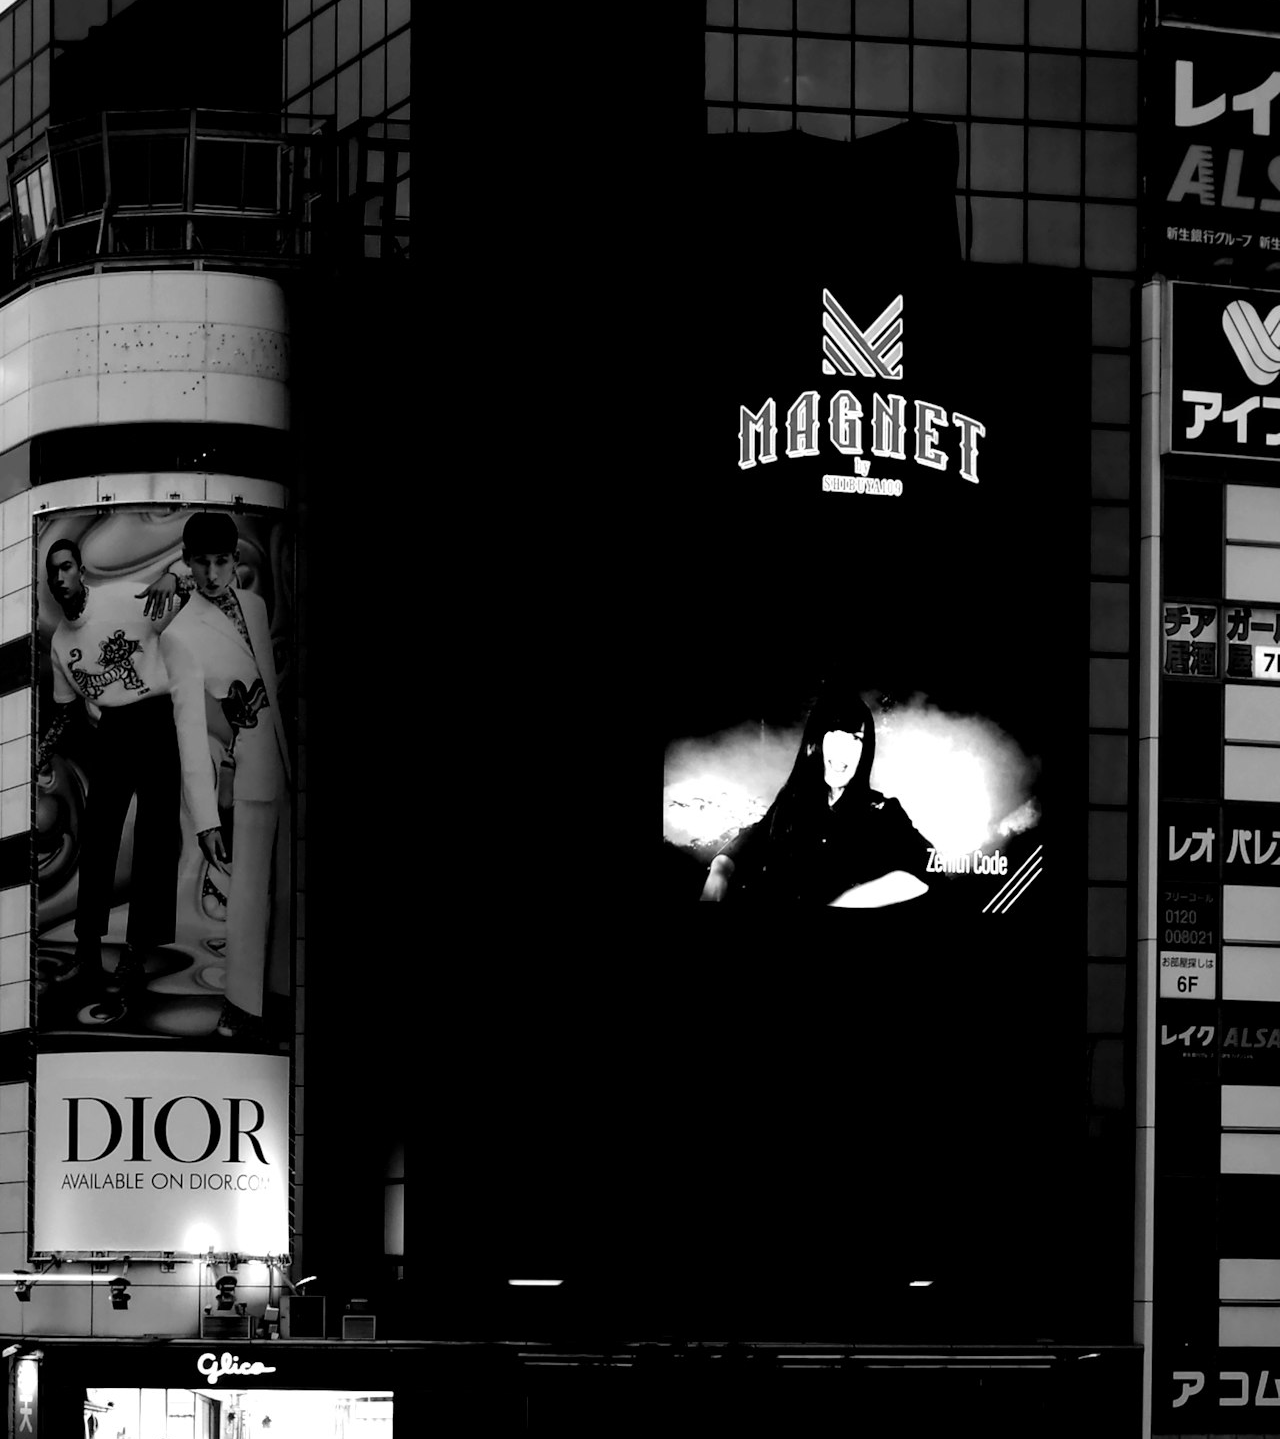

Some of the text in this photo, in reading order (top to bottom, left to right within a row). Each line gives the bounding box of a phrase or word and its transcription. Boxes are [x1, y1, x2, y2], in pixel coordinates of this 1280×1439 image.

[1166, 226, 1253, 249] 新生銀行グループ
[738, 390, 986, 484] MAGNET
[854, 457, 871, 477] by
[822, 474, 904, 497] SHIBUYA109
[1263, 652, 1280, 673] 7
[973, 849, 1008, 875] Code
[1165, 909, 1198, 924] 0120
[1177, 975, 1199, 993] 6F
[1160, 1024, 1216, 1047] レイク
[61, 1096, 271, 1165] DIOR
[61, 1172, 145, 1190] AVAILABLE
[151, 1172, 183, 1190] ON
[197, 1351, 277, 1385] Glico
